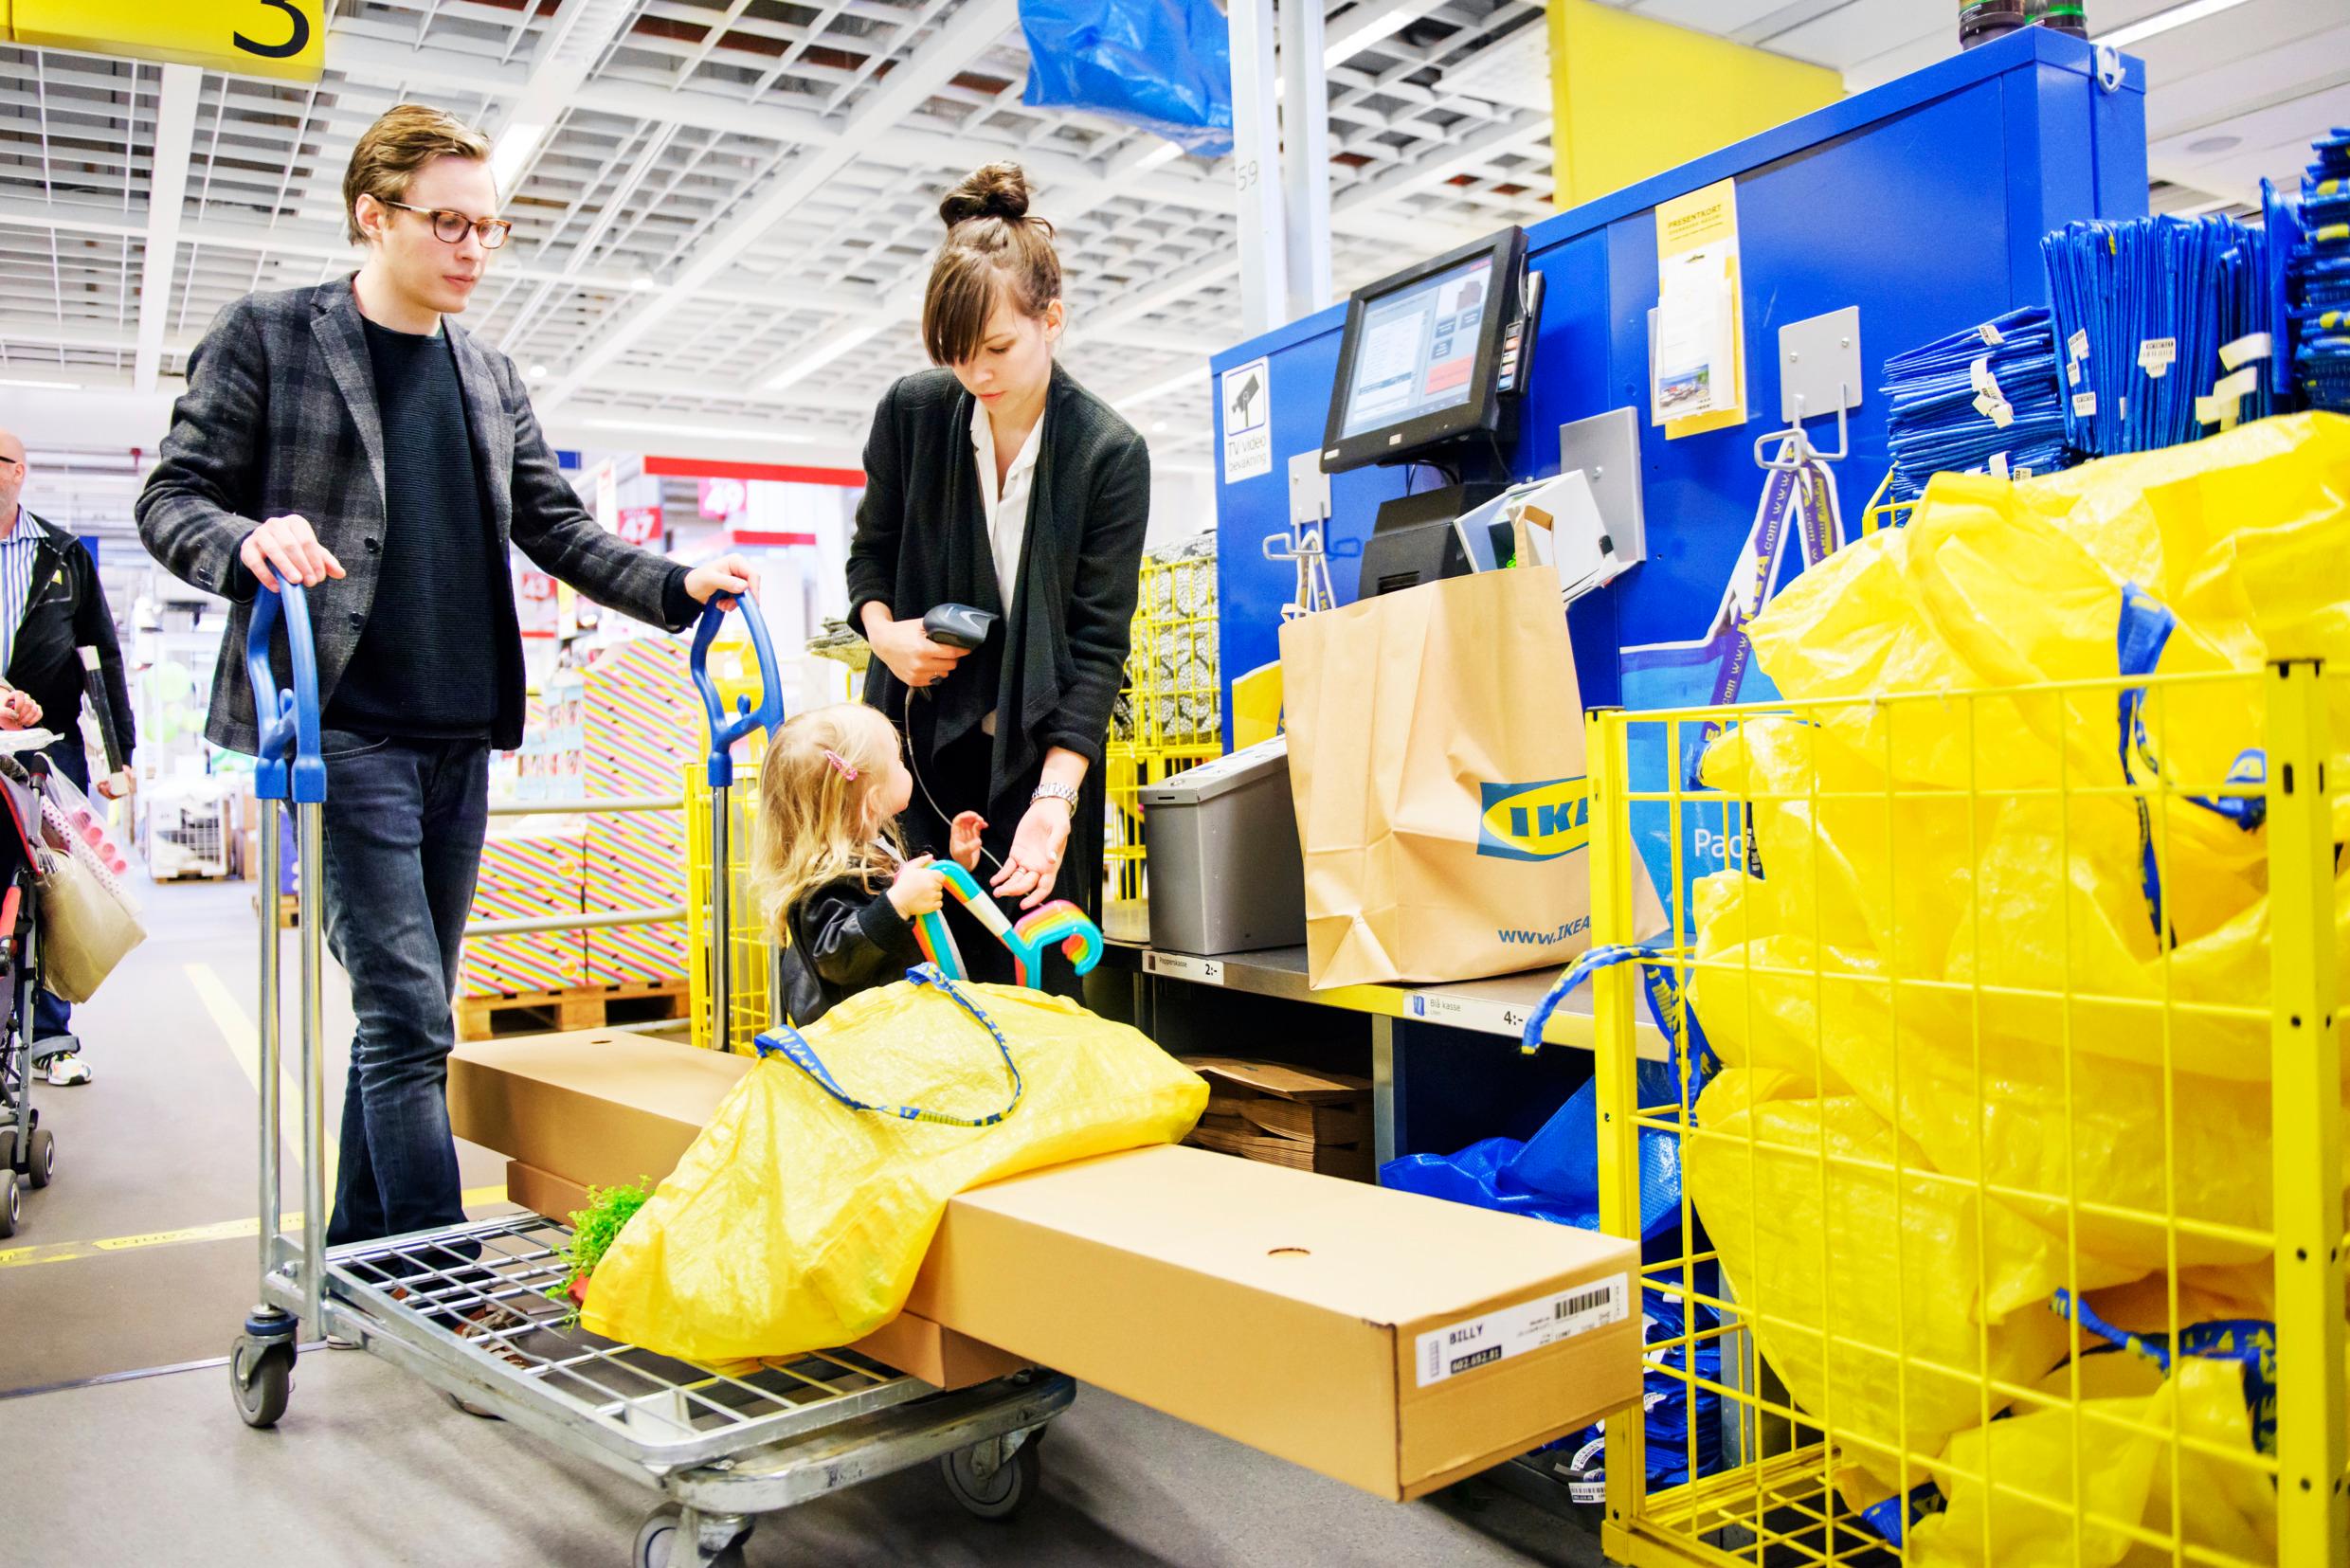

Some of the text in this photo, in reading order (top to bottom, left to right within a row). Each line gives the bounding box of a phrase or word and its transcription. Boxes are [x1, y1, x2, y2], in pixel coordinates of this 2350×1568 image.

[1238, 160, 1258, 191] 59
[1668, 204, 1722, 227] PRESENTKORT
[1228, 434, 1266, 457] TV video
[1229, 453, 1266, 473] bevakning
[621, 514, 655, 542] 47
[1694, 828, 1742, 858] Pac
[1204, 963, 1218, 977] 2:-
[1430, 998, 1524, 1026] Blå kasse 4:-
[1450, 1324, 1484, 1345] BILLY
